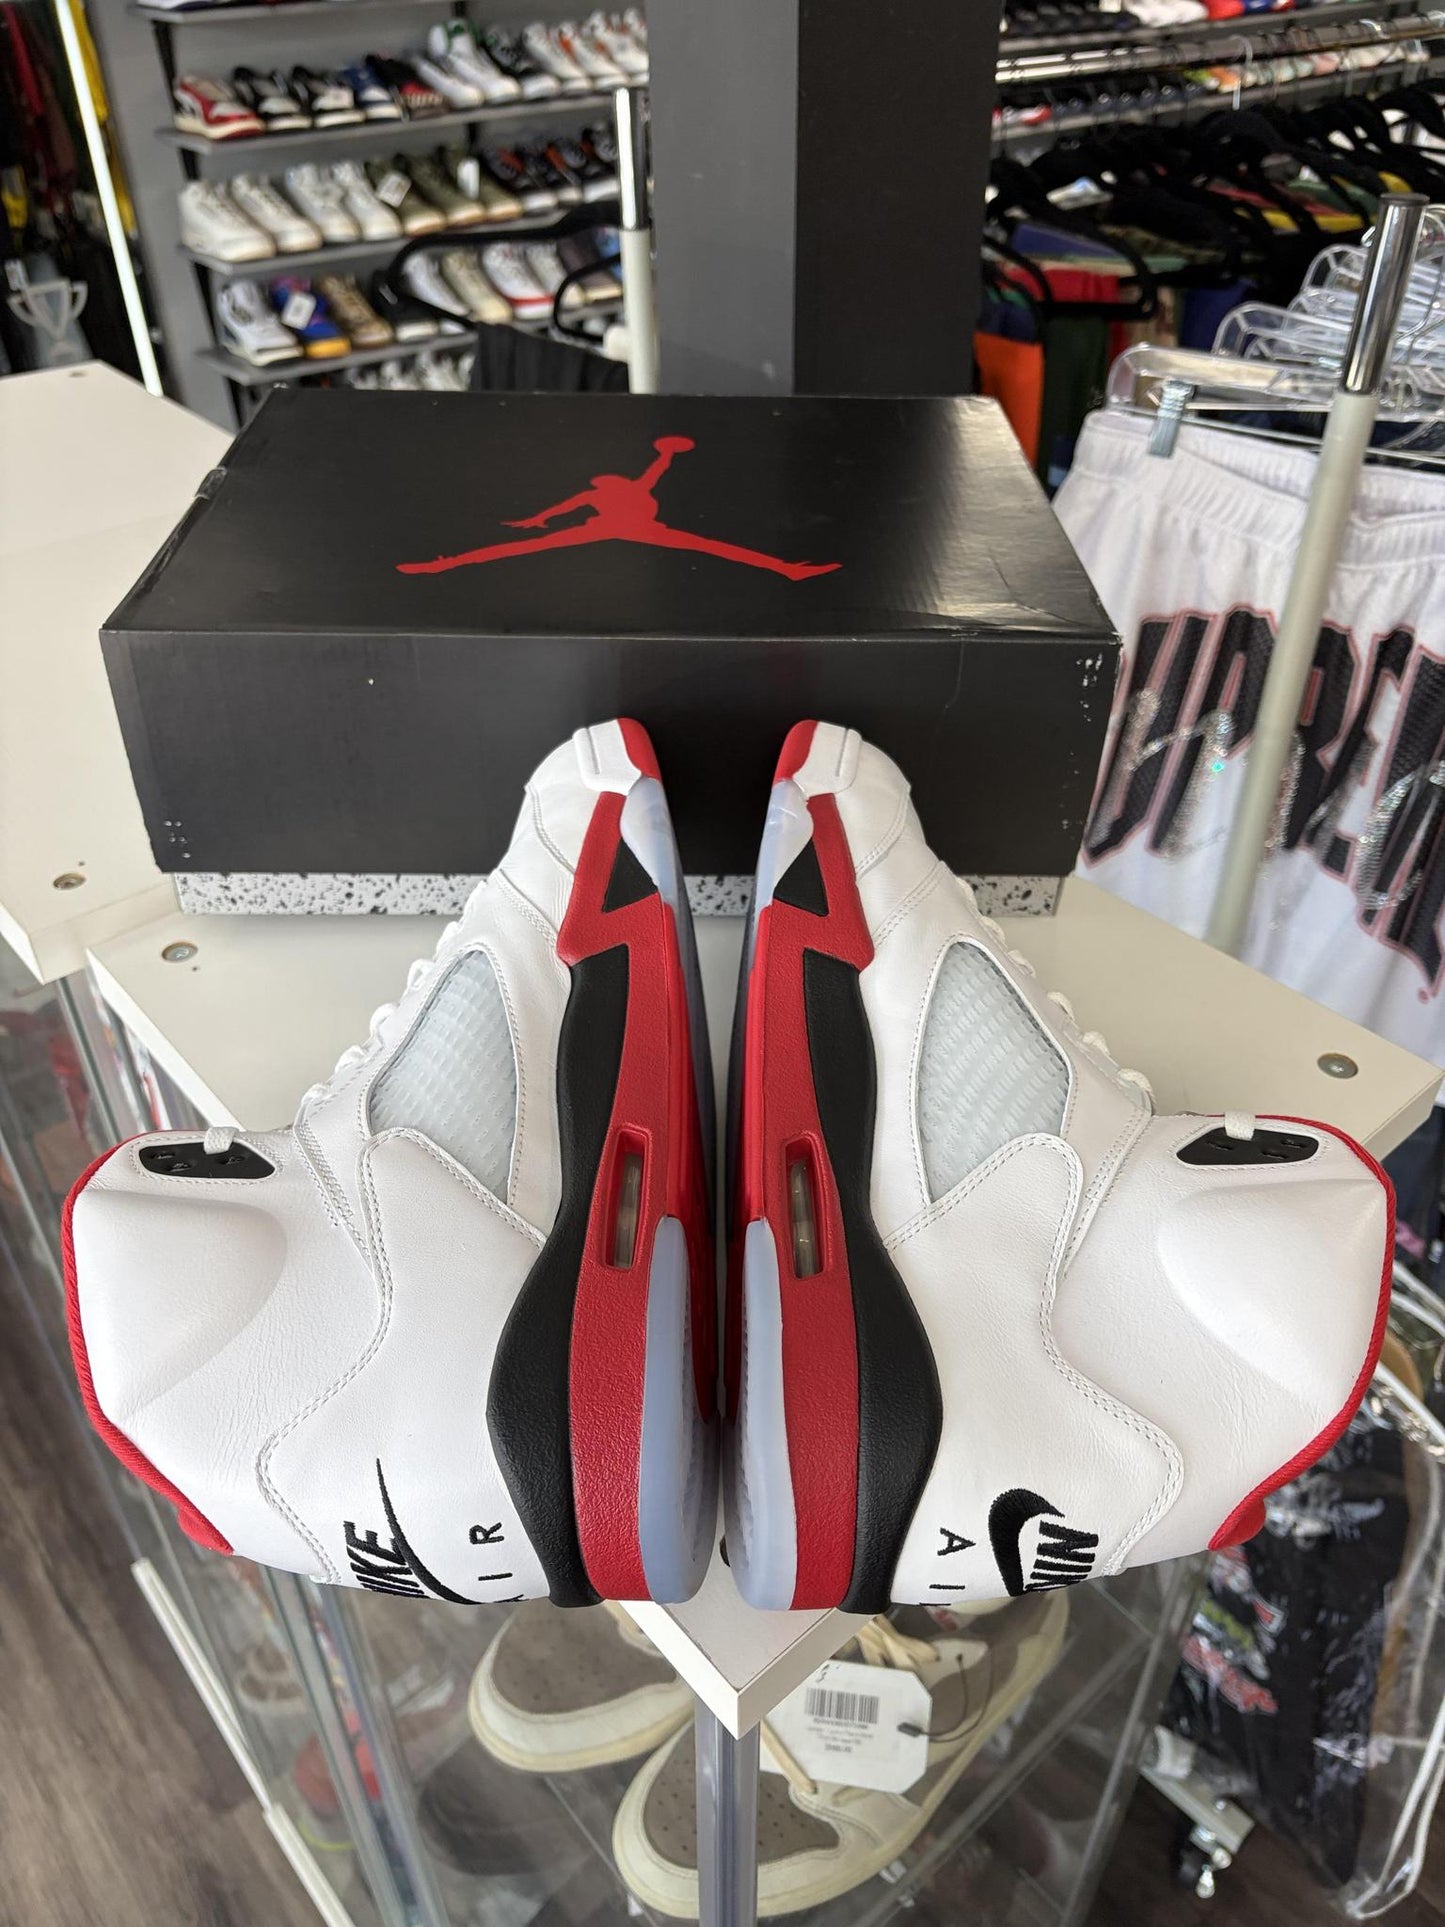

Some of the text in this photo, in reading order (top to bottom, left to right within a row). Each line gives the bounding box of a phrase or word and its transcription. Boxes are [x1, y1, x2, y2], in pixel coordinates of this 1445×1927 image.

[343, 1520, 431, 1599] IKE
[469, 1522, 529, 1604] IR
[919, 1528, 976, 1605] AI
[1024, 1520, 1099, 1594] NIK
